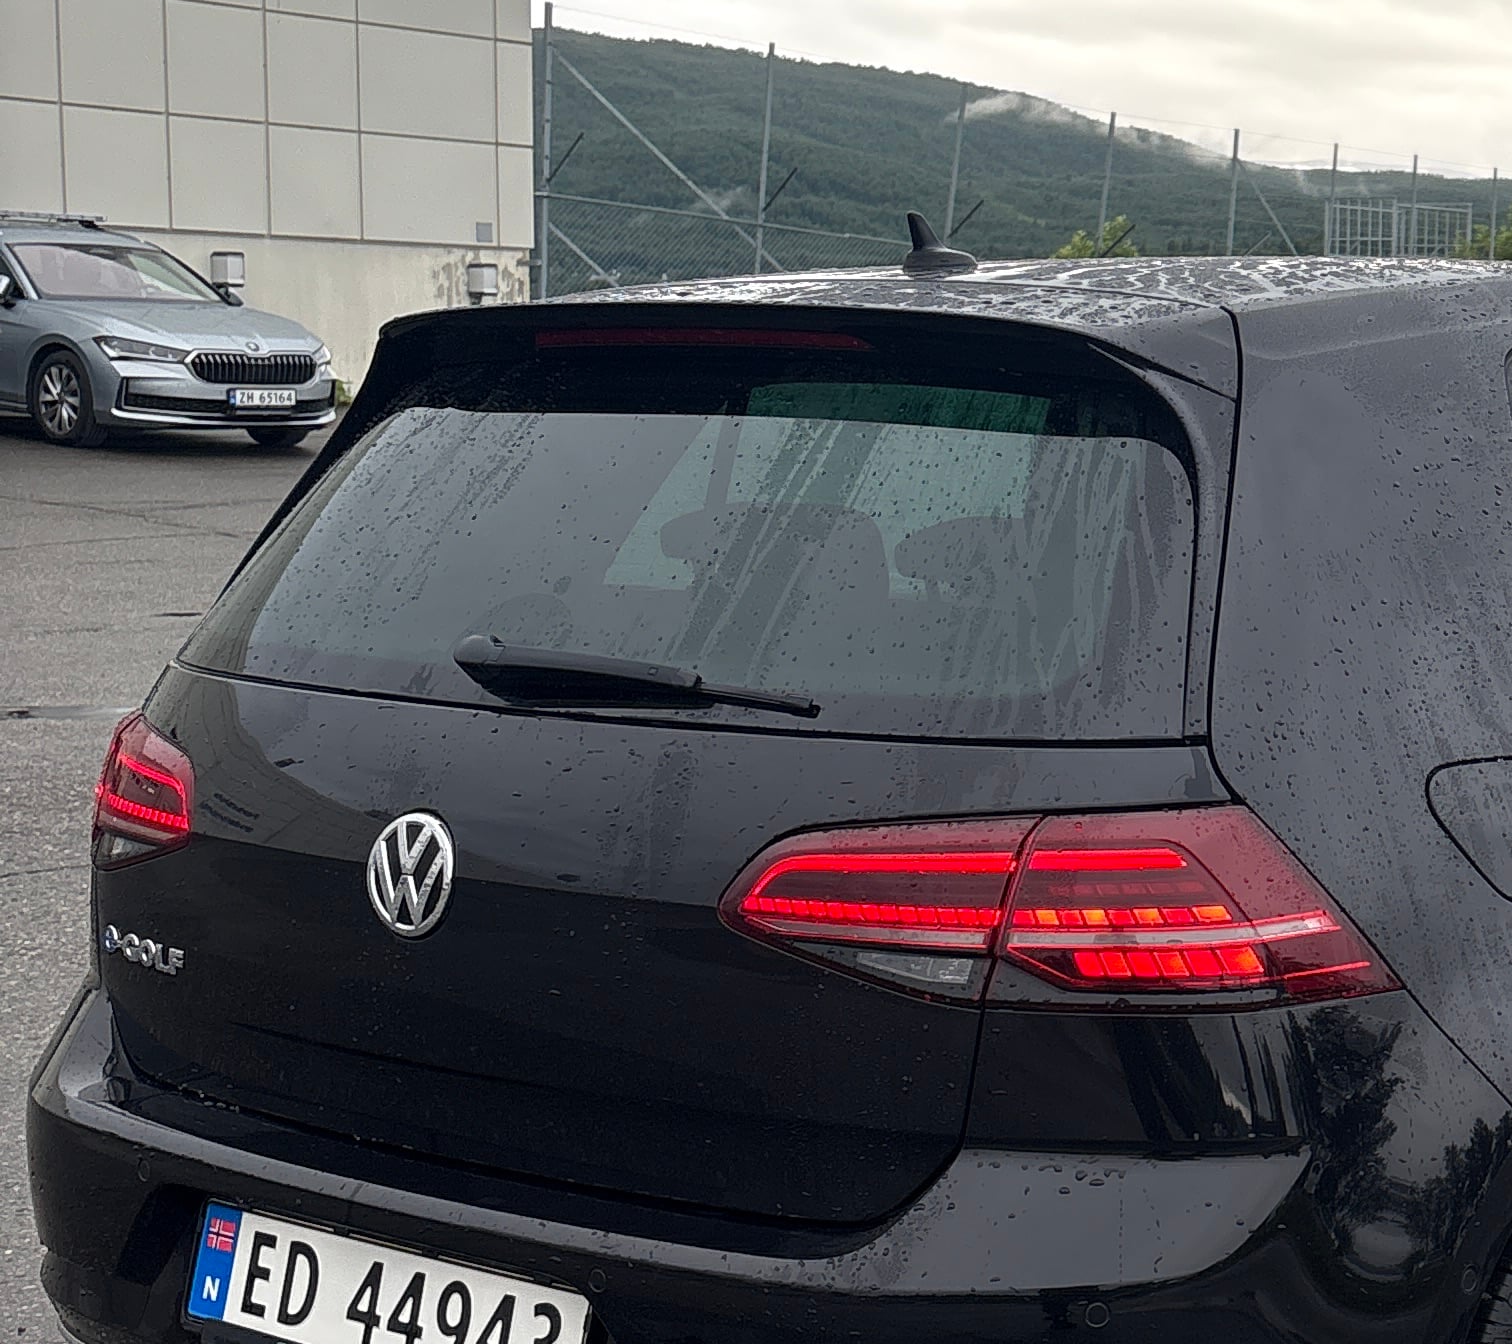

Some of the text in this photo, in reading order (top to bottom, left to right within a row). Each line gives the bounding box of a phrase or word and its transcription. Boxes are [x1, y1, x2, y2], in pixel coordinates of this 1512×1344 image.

[240, 391, 254, 404] ZH
[259, 392, 293, 404] 65164
[202, 1274, 220, 1302] N
[240, 1231, 320, 1327] ED
